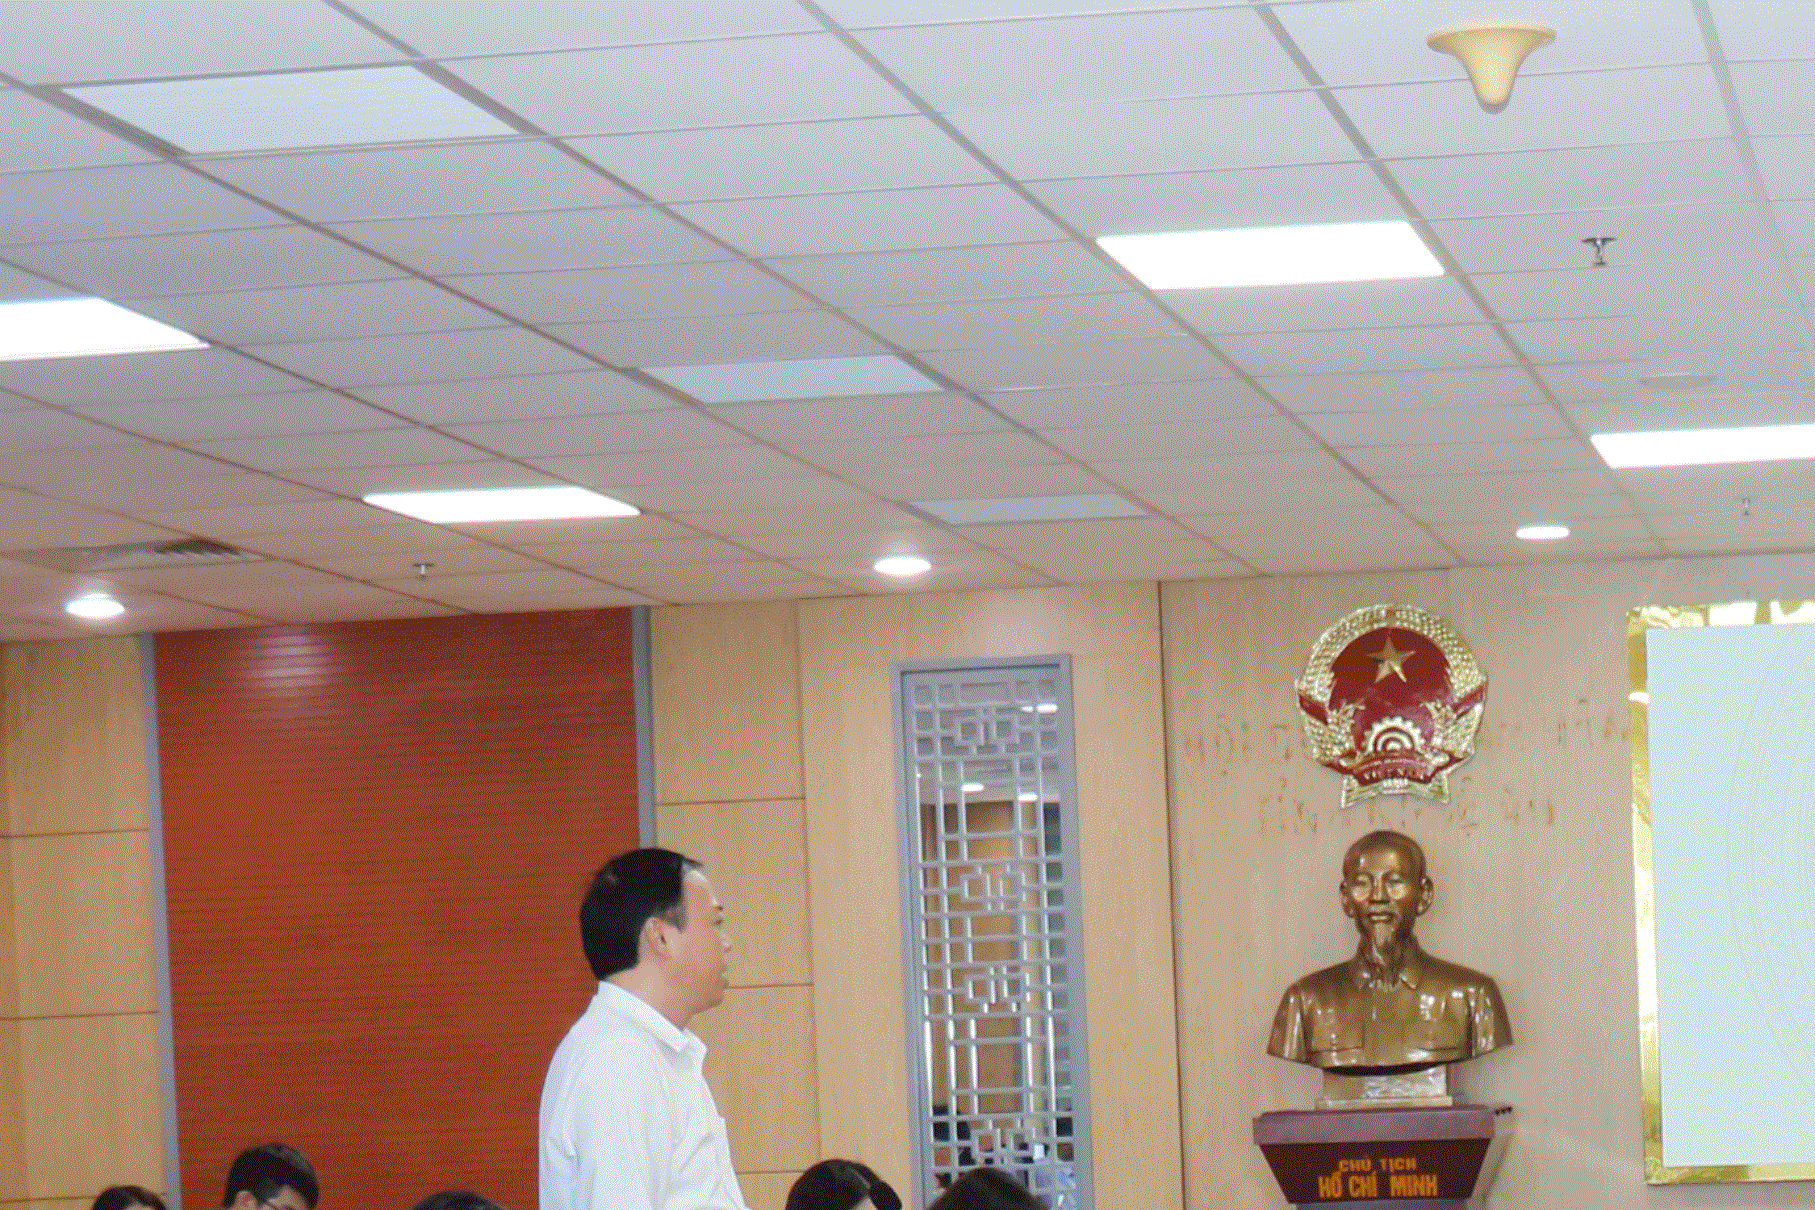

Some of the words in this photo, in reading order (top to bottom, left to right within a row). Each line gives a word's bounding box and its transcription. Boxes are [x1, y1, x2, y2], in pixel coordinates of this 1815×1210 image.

[1379, 1156, 1418, 1173] TỊCH
[1348, 1170, 1378, 1198] CHÍ
[1389, 1174, 1439, 1197] MINH
